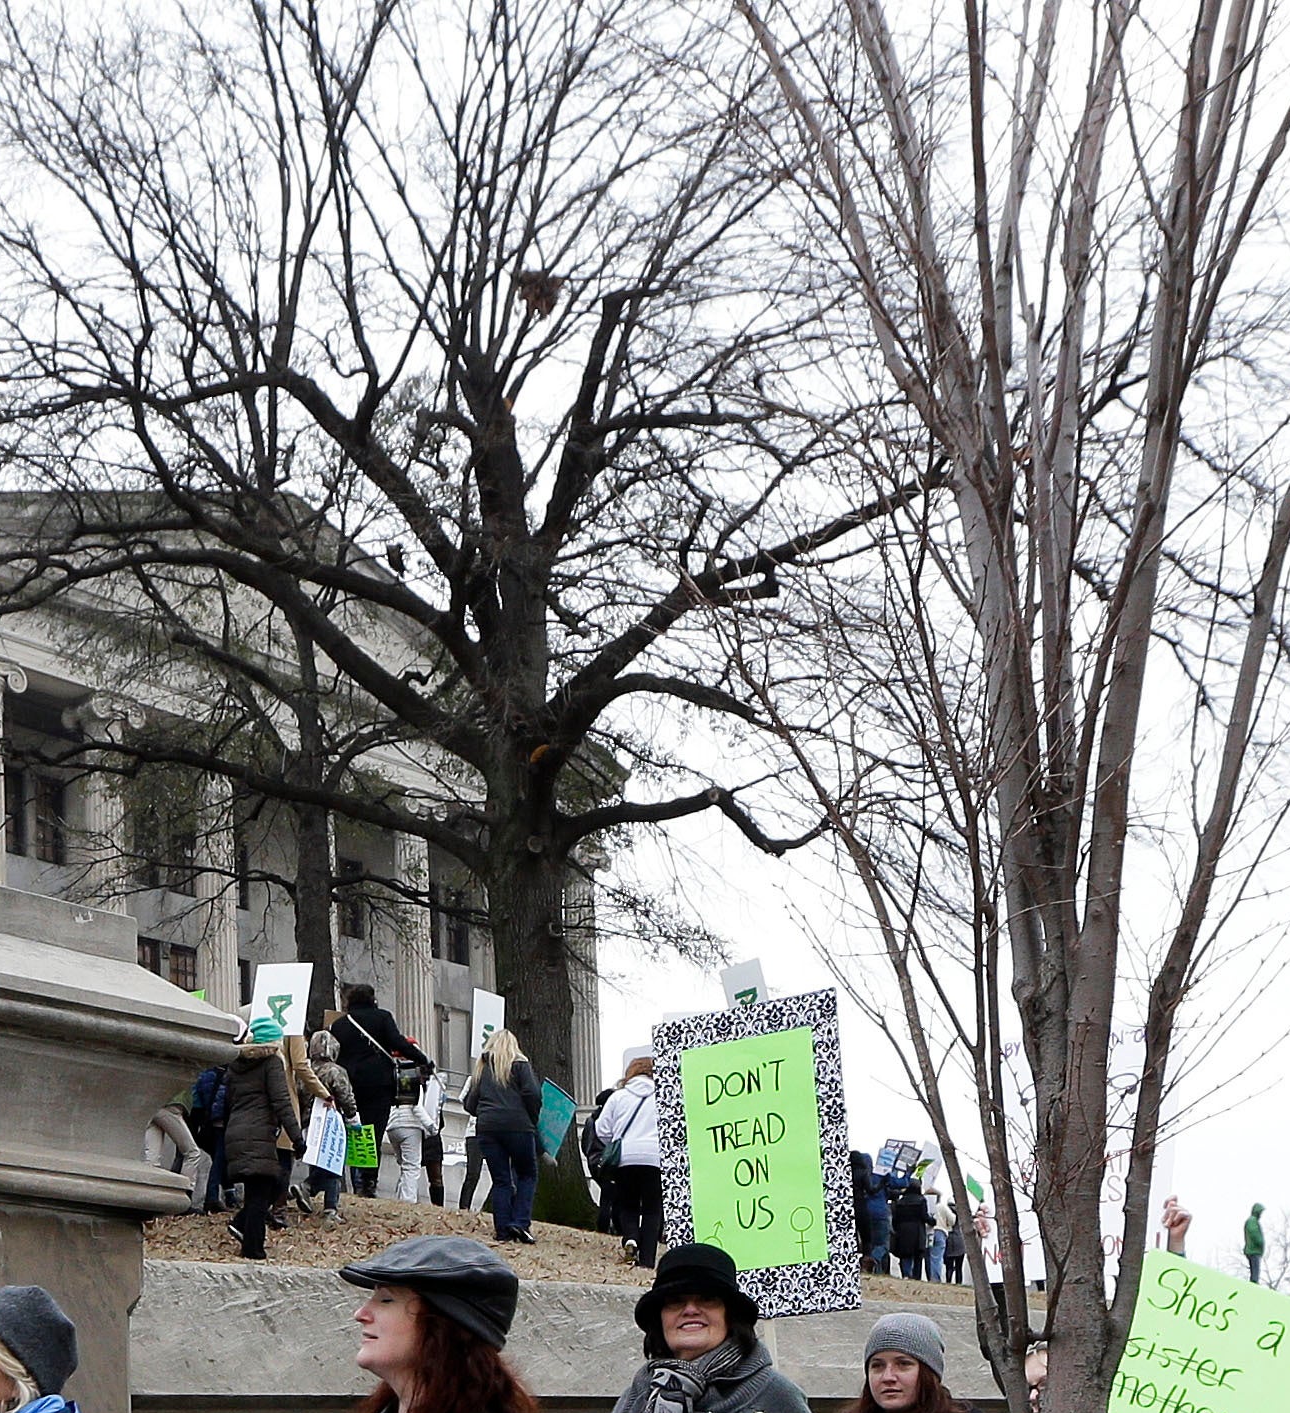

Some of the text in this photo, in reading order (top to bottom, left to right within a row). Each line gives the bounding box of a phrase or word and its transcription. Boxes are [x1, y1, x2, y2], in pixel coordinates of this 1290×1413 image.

[705, 1058, 786, 1106] DON'T
[705, 1111, 786, 1154] TREAD
[733, 1153, 770, 1188] ON
[735, 1194, 775, 1231] US
[1147, 1268, 1286, 1357] She's a
[1124, 1333, 1244, 1391] sister
